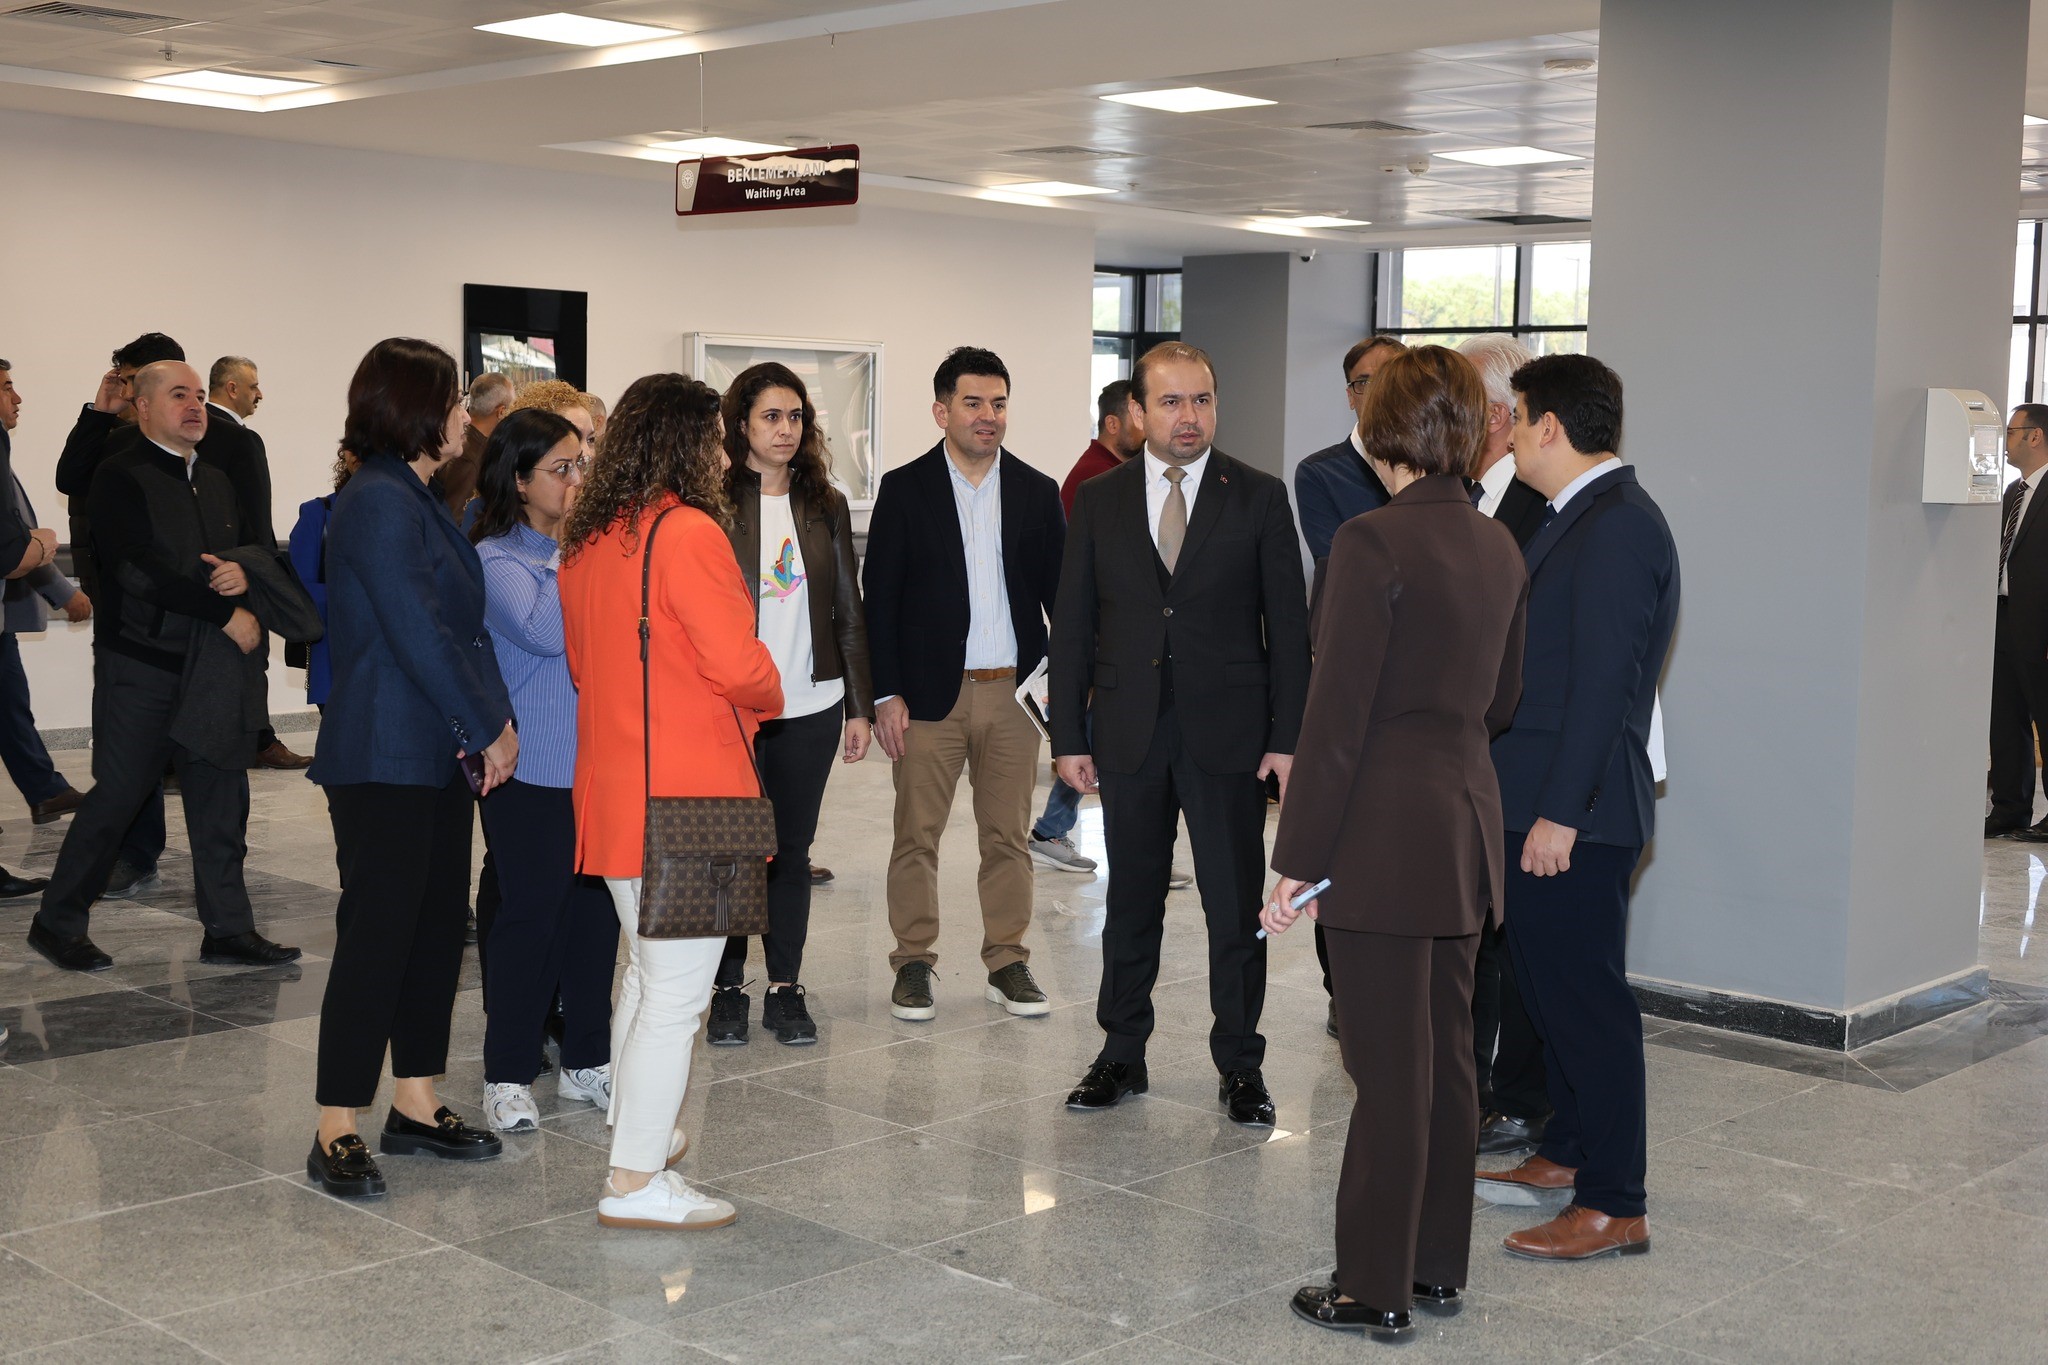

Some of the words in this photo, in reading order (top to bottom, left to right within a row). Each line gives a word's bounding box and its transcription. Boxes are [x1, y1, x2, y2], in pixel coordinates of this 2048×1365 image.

[727, 166, 784, 183] BEKLEME
[786, 162, 826, 178] ALANI
[745, 186, 782, 200] Waiting
[783, 186, 806, 197] Area
